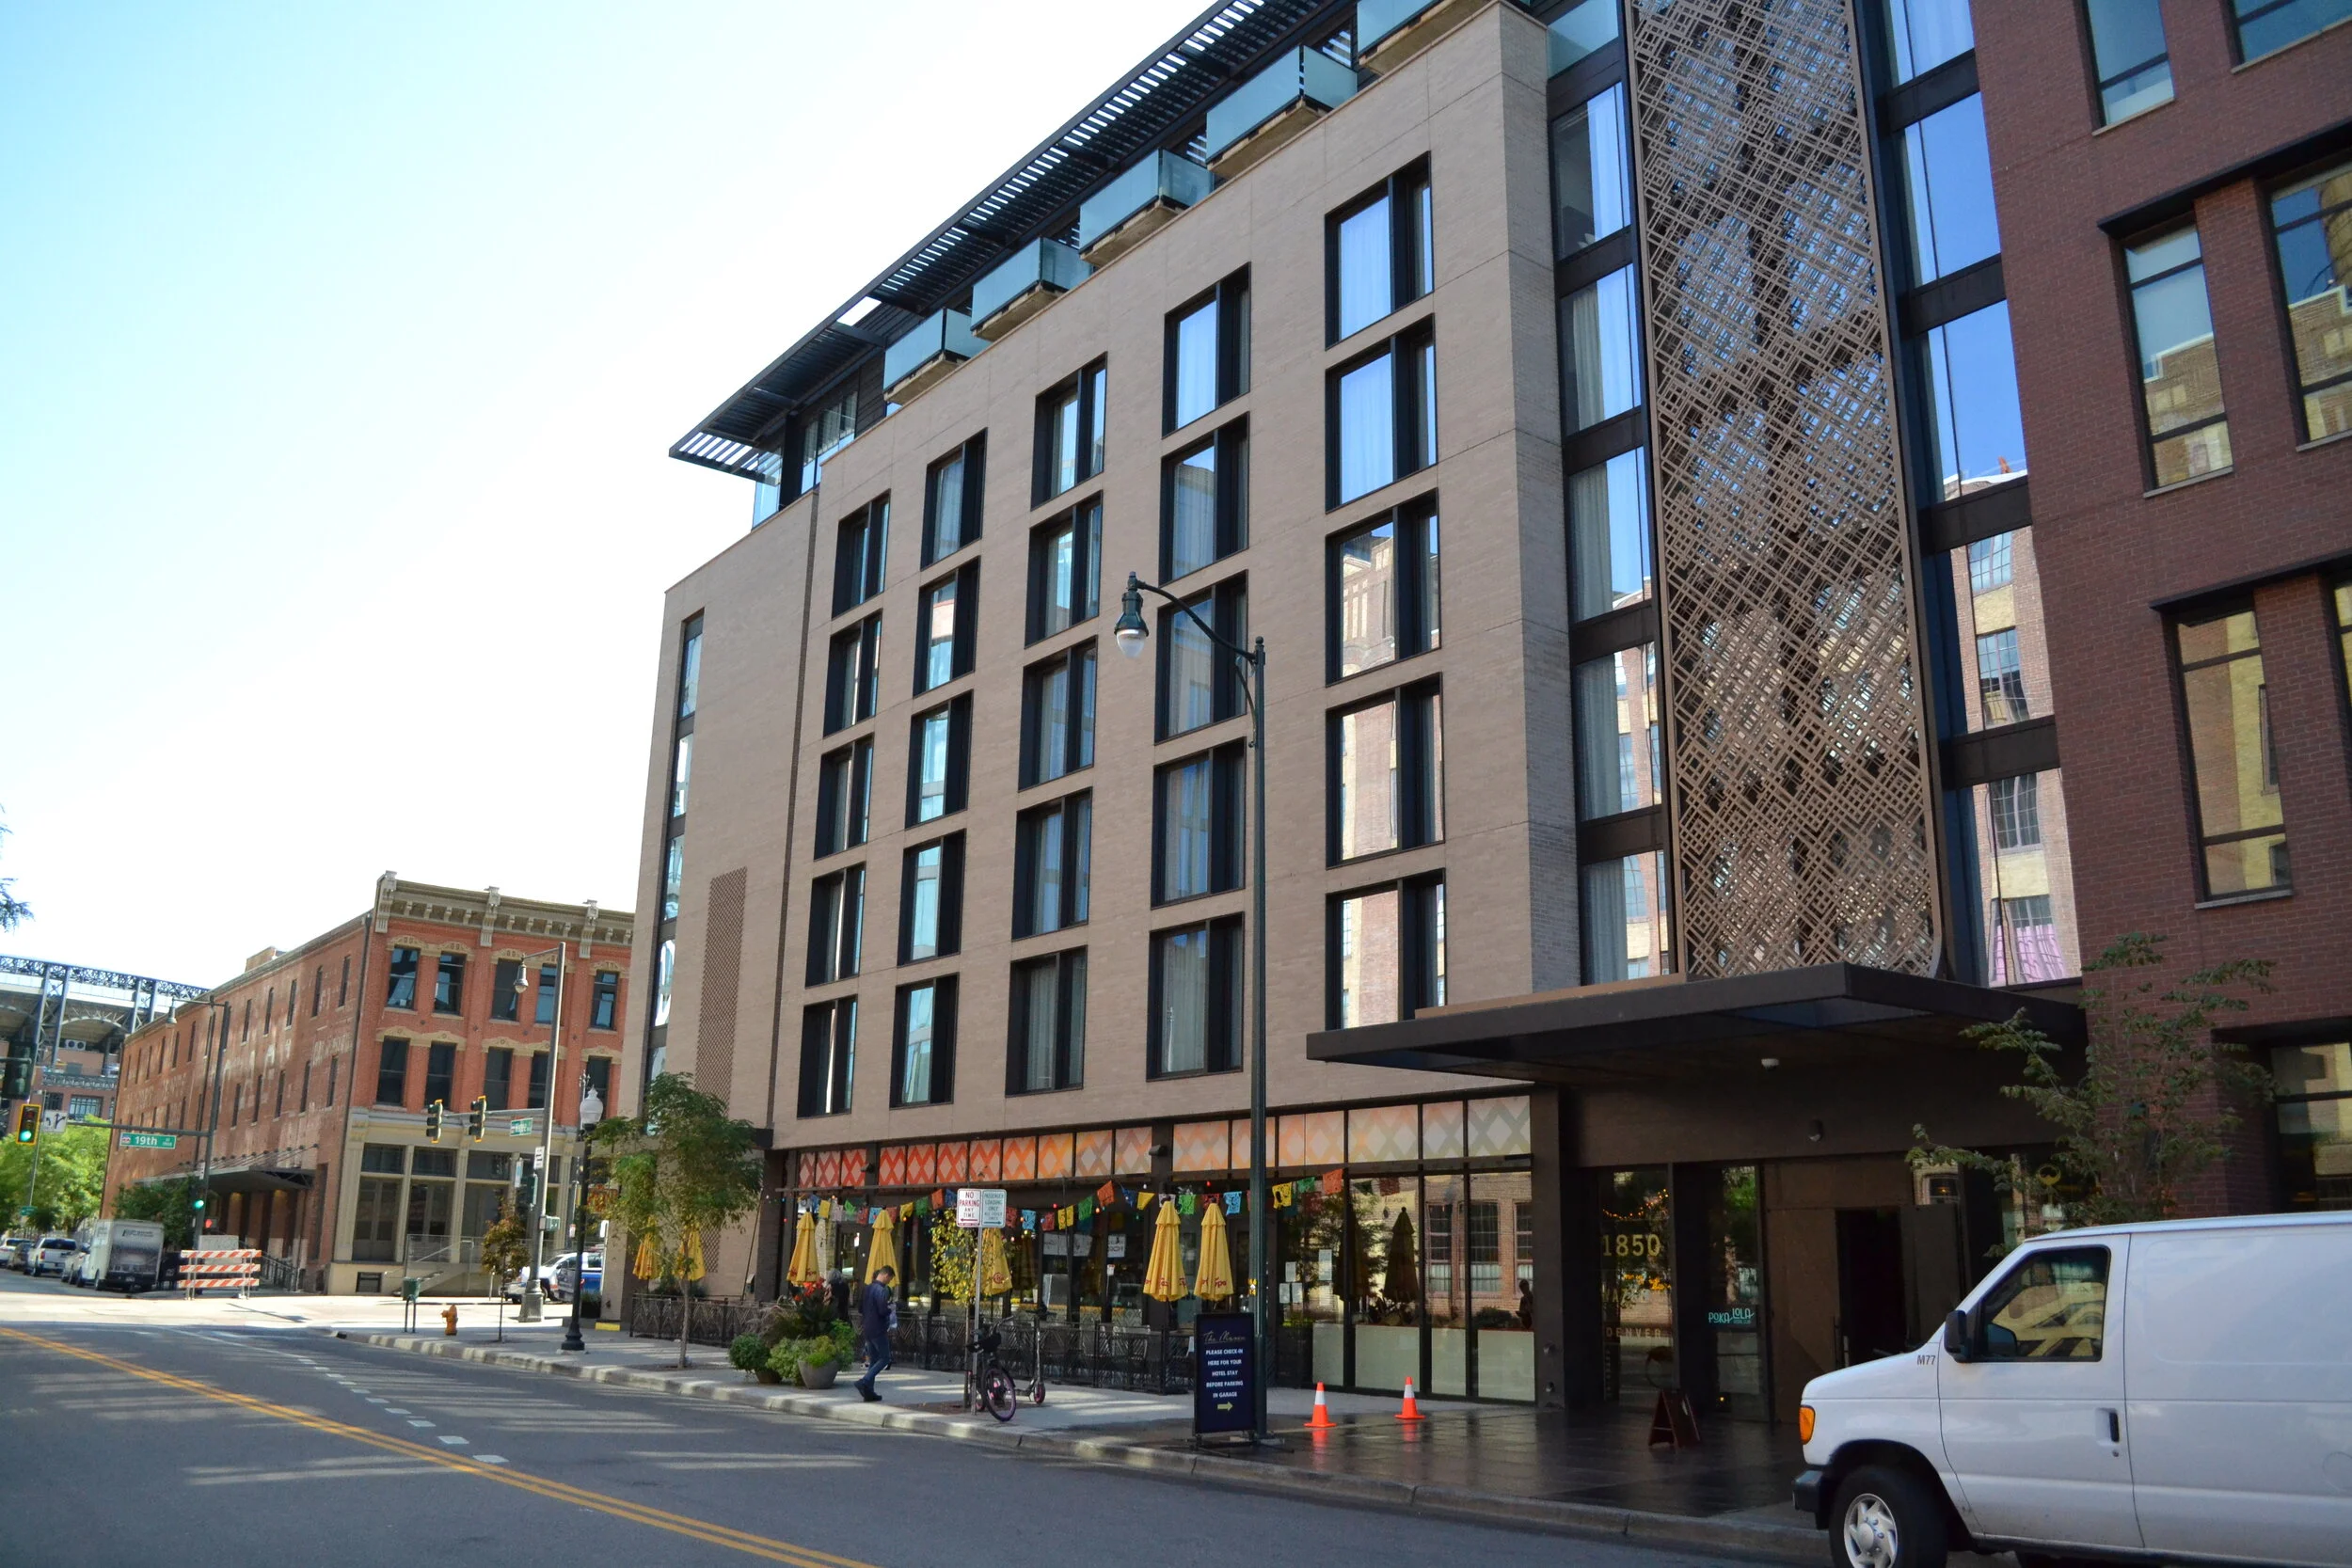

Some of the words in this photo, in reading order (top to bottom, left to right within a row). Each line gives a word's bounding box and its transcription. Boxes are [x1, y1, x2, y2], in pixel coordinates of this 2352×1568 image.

[135, 1135, 158, 1146] 19th
[1602, 1234, 1661, 1257] 1850
[1708, 1312, 1732, 1323] POKA
[1732, 1307, 1755, 1320] LOLA
[1204, 1330, 1216, 1342] The
[1605, 1326, 1661, 1339] DENVER
[1917, 1354, 1936, 1365] M77
